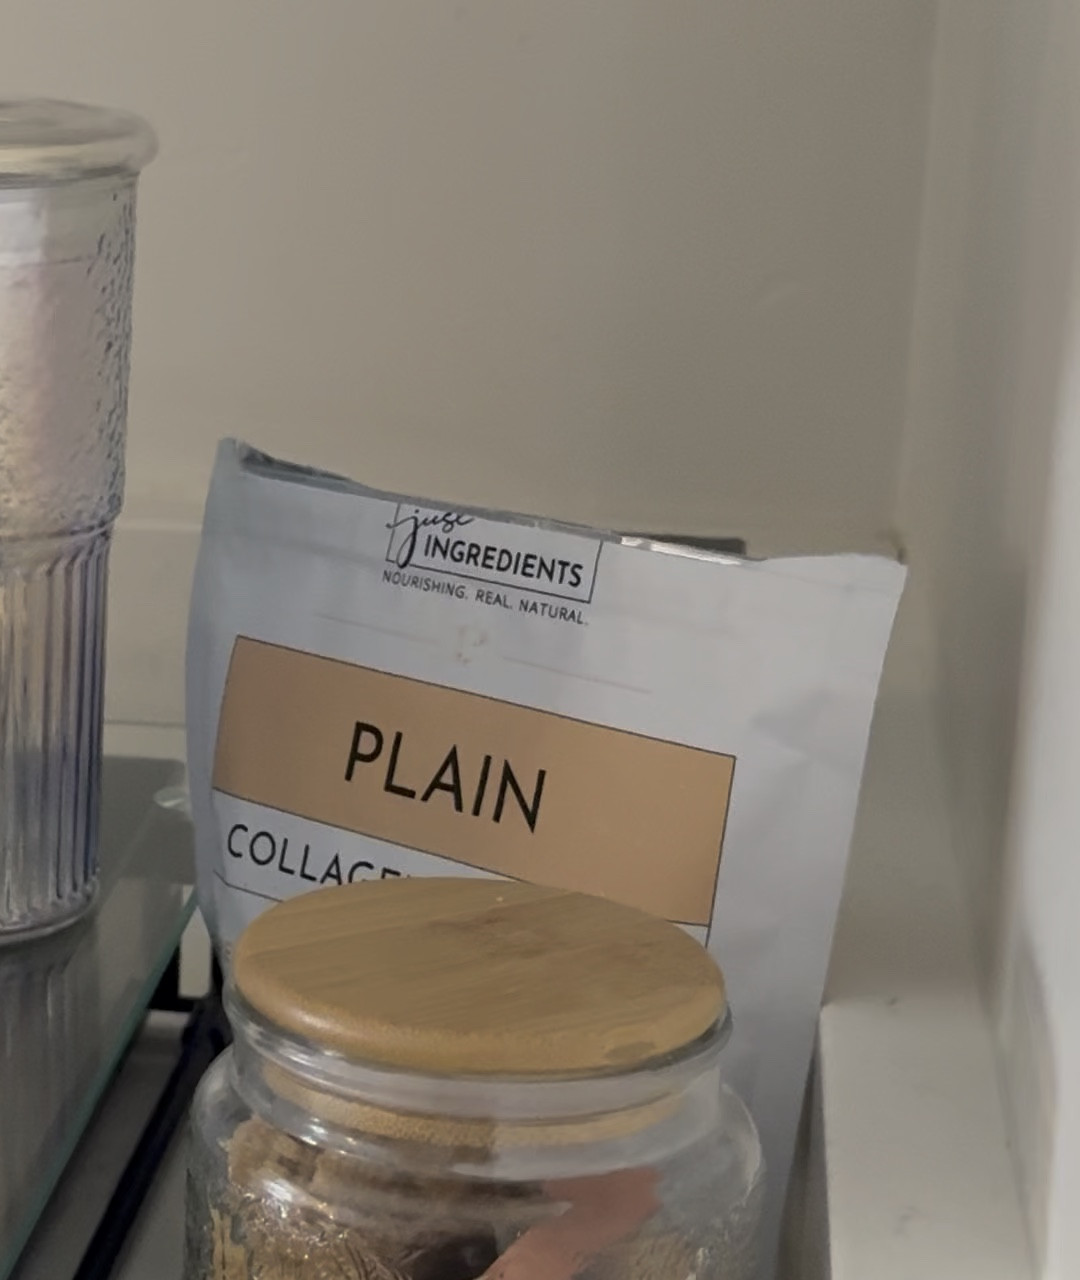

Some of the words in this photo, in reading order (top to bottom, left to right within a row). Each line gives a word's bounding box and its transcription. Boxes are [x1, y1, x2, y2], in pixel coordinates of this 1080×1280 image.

[424, 534, 584, 588] INGREDIENTS
[382, 570, 468, 600] NOURISHING.
[475, 589, 513, 609] REAL.
[519, 598, 590, 626] NATURAL.
[344, 721, 547, 833] PLAIN
[227, 823, 411, 886] COLLAG
